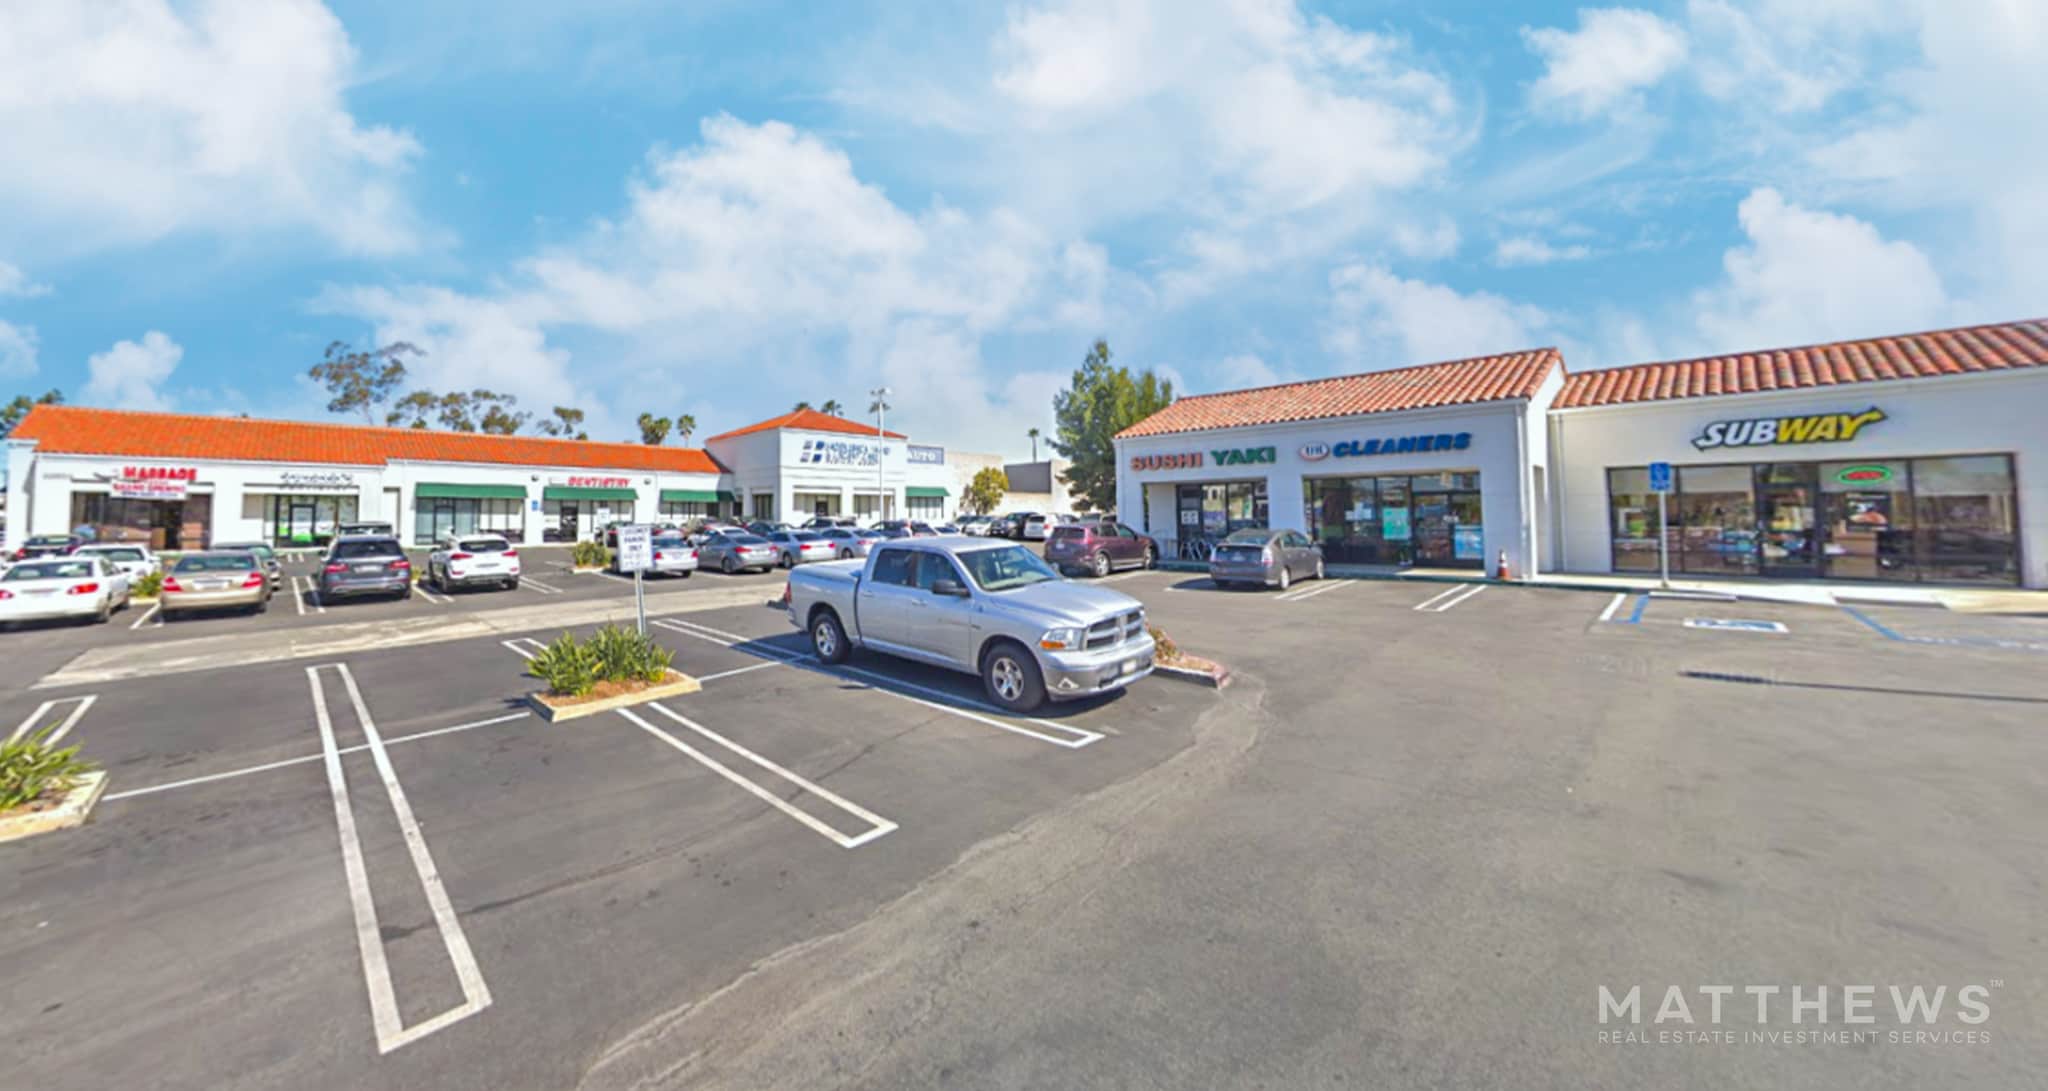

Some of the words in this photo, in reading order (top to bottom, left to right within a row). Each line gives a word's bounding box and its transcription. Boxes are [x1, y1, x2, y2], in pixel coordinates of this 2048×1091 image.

[1693, 408, 1886, 450] SUBWAY
[1333, 432, 1472, 458] CLEANERS
[1131, 452, 1204, 471] SUSHI
[1210, 446, 1276, 466] YAKI
